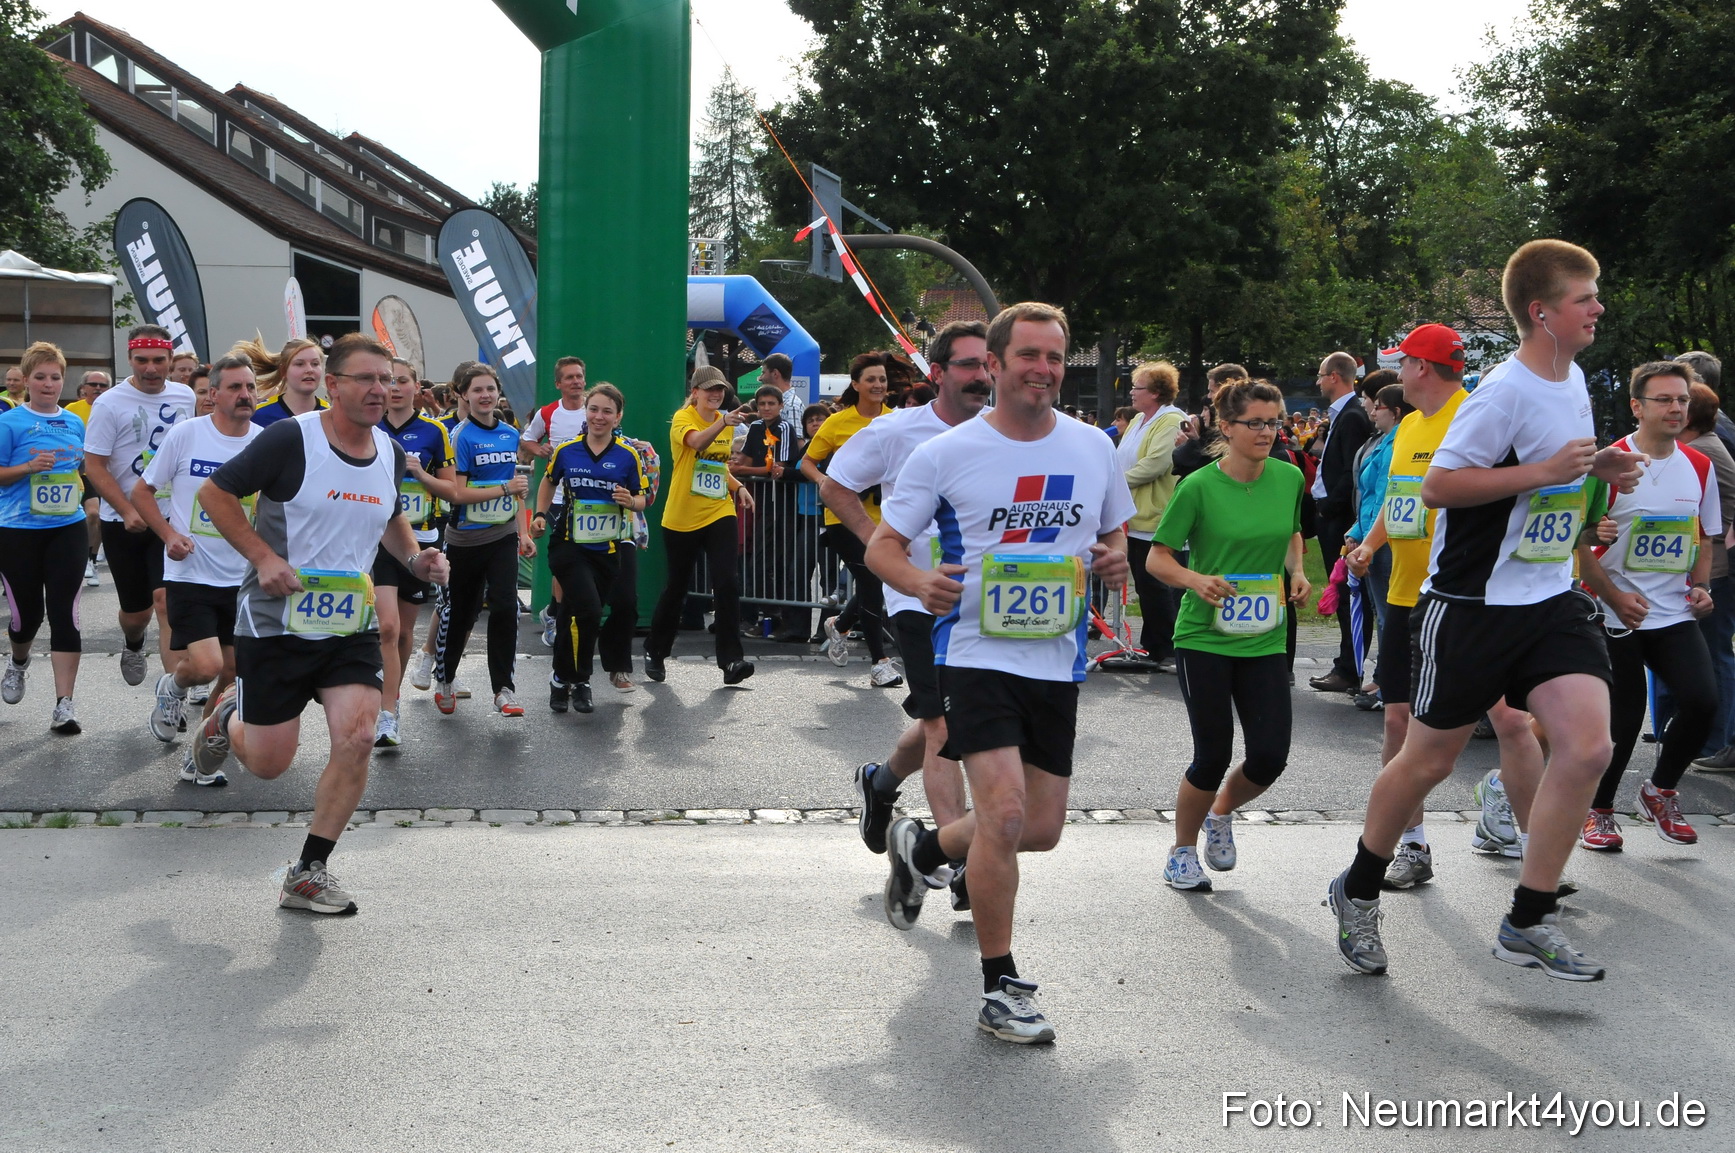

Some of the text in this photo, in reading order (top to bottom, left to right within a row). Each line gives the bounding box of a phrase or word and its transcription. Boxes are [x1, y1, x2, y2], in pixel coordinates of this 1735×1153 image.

[570, 477, 620, 491] BOCK
[697, 472, 721, 490] 188
[37, 485, 73, 504] 687
[343, 492, 383, 505] KLEBL
[988, 504, 1084, 531] PERRAS
[1009, 502, 1070, 513] AUTOHAUS
[1387, 497, 1416, 523] 182
[576, 515, 617, 531] 1071
[1524, 512, 1572, 543] 483
[1634, 535, 1683, 558] 864
[296, 592, 354, 619] 484
[987, 584, 1066, 615] 1261
[1222, 596, 1270, 621] 820
